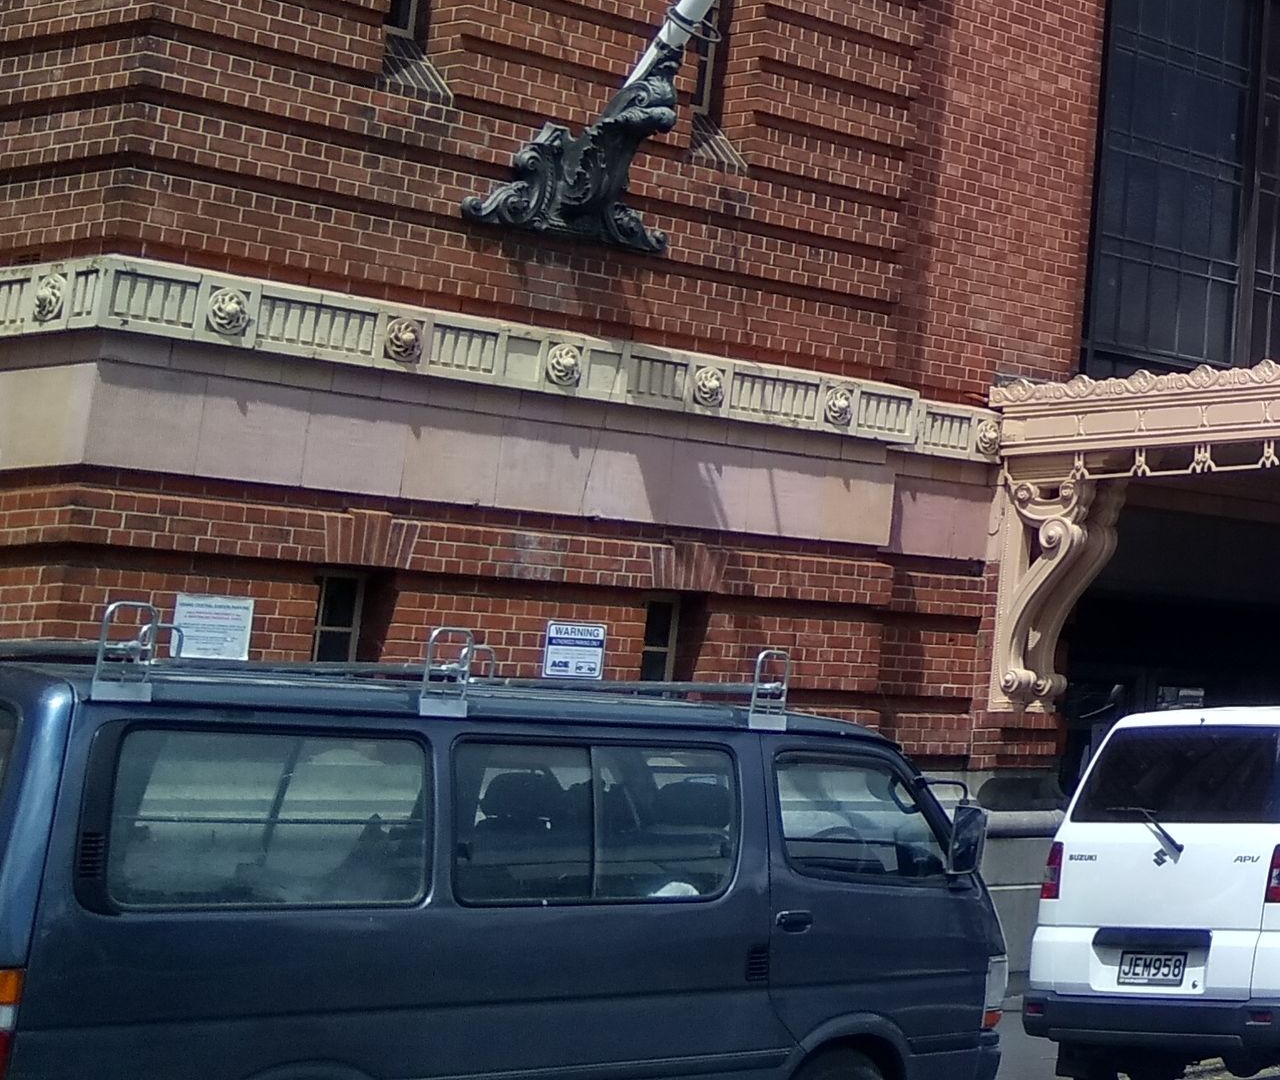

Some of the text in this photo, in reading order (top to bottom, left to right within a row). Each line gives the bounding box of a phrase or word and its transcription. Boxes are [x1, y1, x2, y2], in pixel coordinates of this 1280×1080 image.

[555, 626, 600, 638] WARNING
[551, 660, 570, 668] ACE
[1068, 854, 1098, 862] SUZUKI
[1233, 855, 1261, 863] APV
[1122, 956, 1183, 978] JEM958
